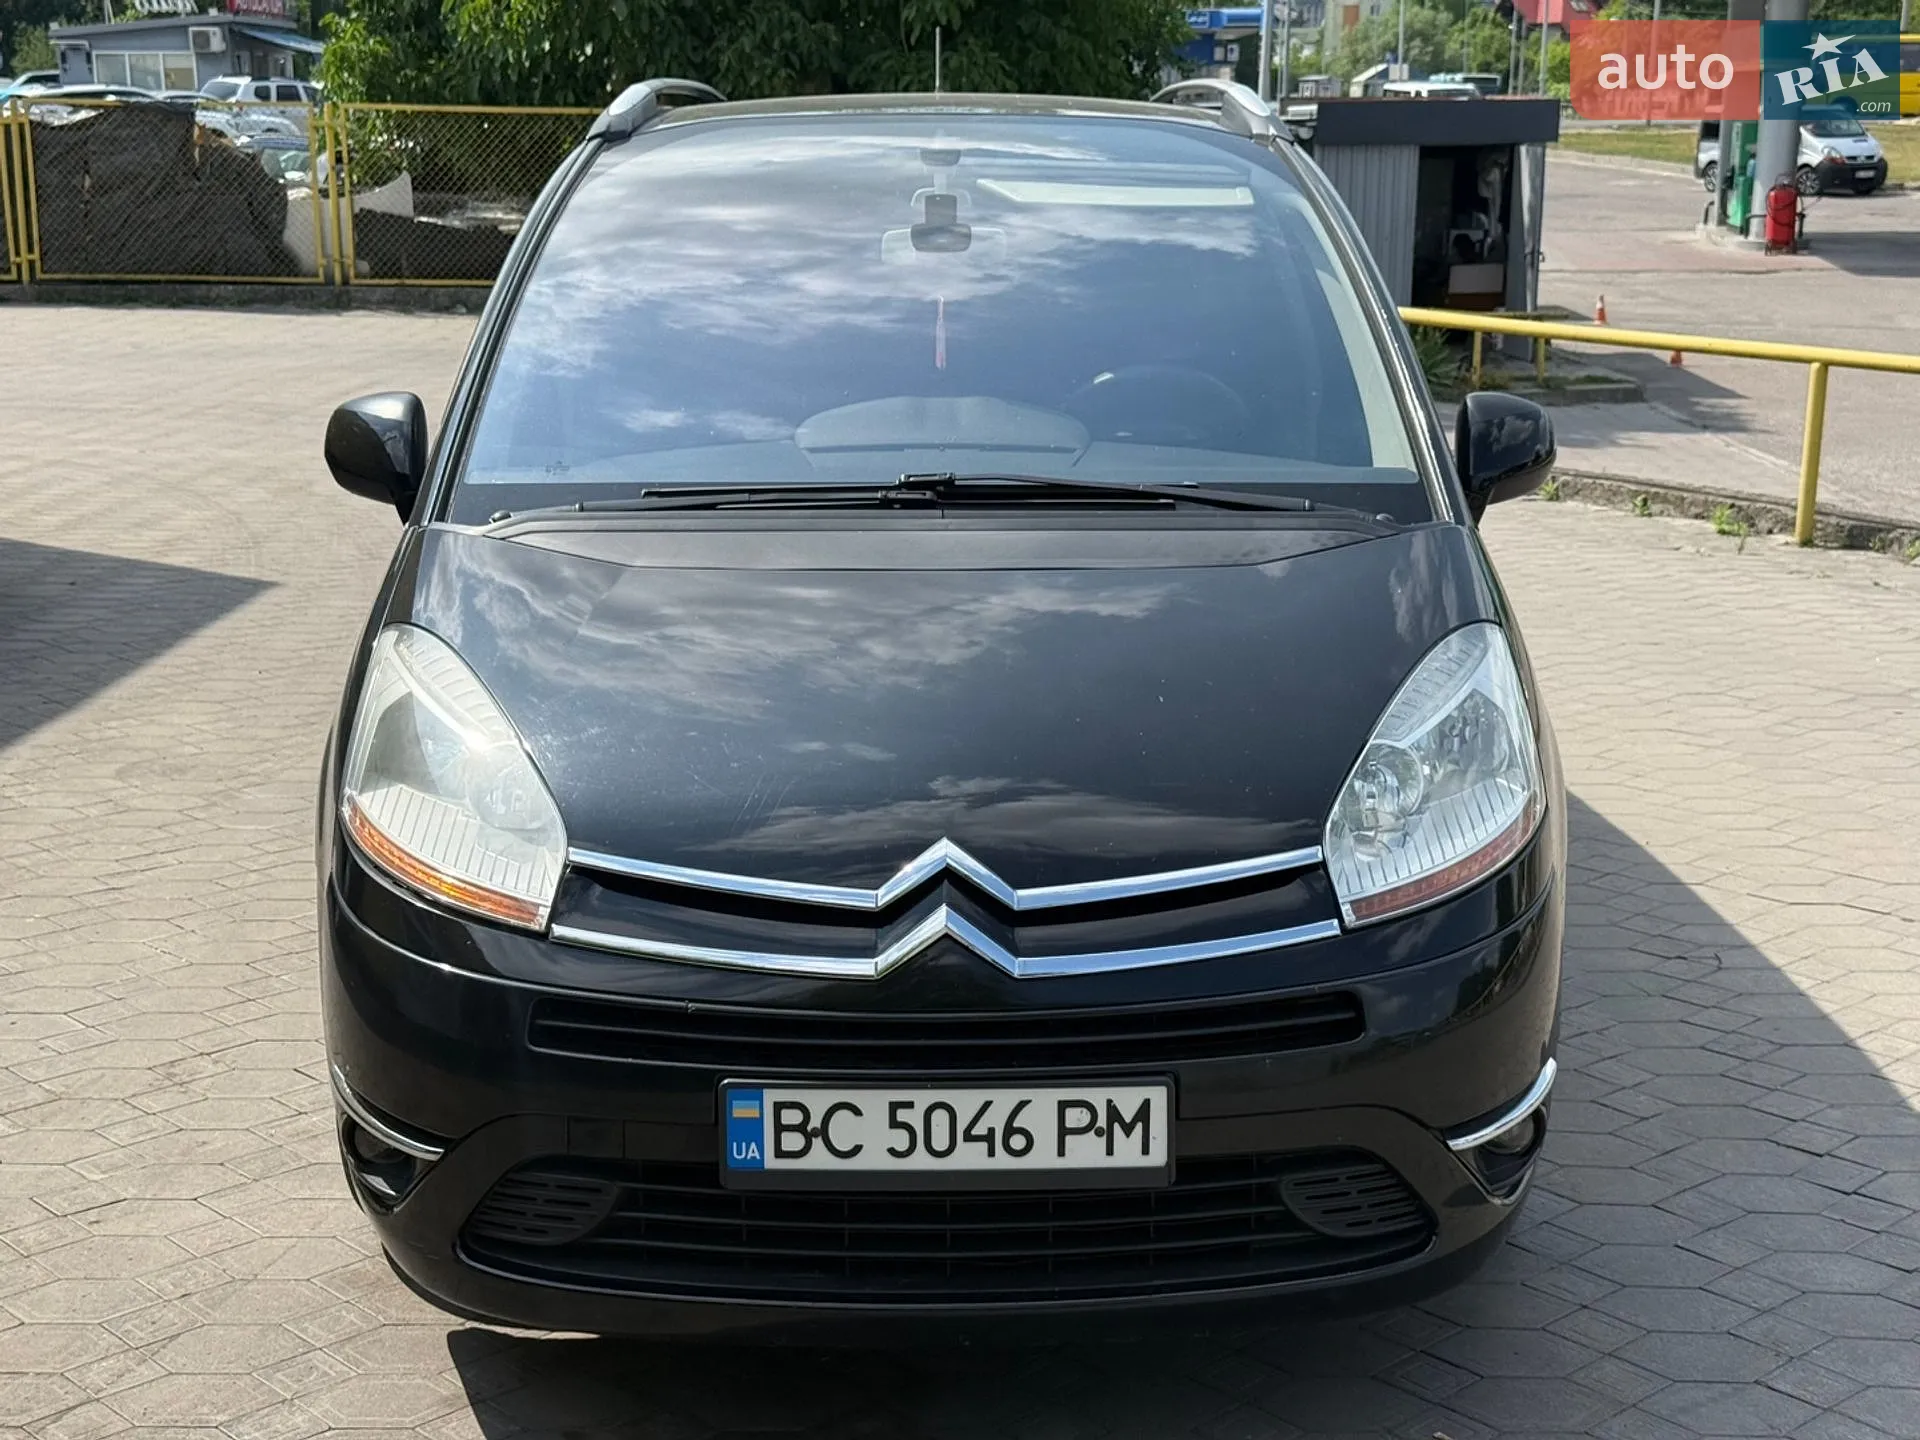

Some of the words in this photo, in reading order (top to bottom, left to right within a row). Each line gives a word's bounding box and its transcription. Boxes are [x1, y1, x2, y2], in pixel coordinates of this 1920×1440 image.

[773, 1101, 864, 1159] BC
[886, 1099, 1035, 1159] 5046
[1057, 1098, 1151, 1158] PM
[732, 1142, 760, 1160] UA
